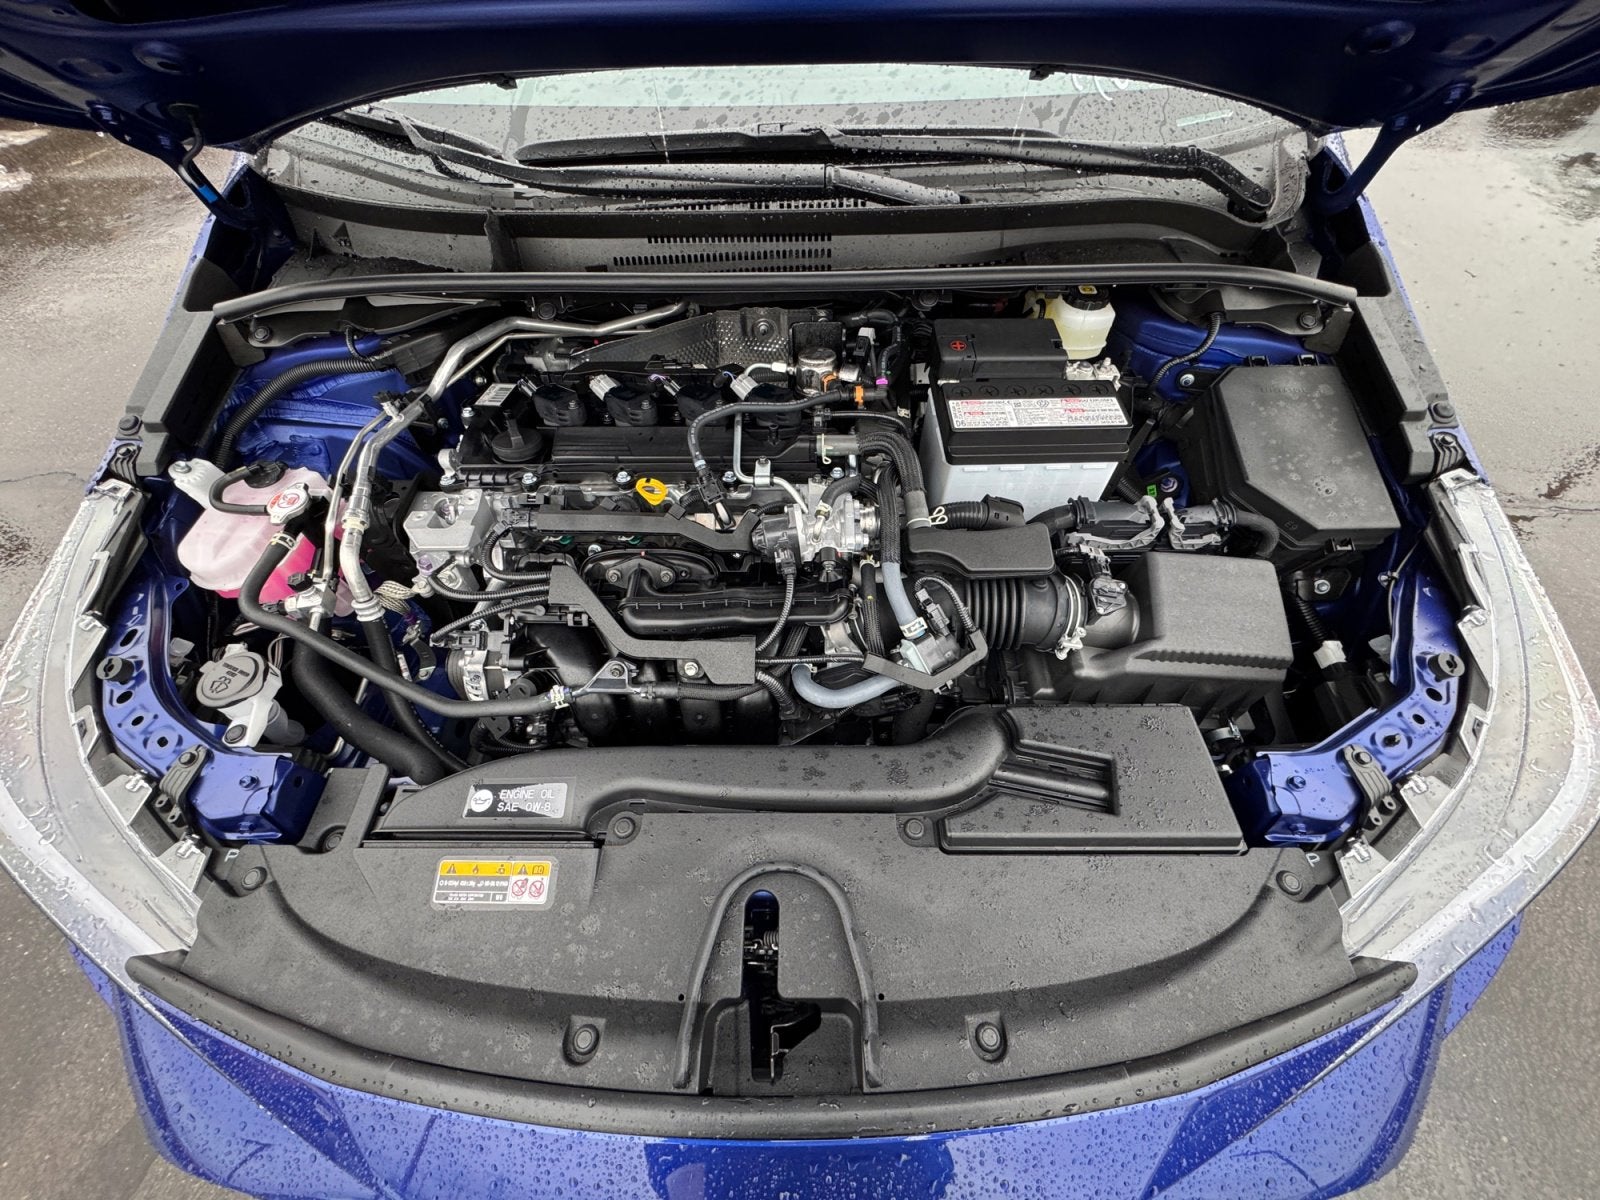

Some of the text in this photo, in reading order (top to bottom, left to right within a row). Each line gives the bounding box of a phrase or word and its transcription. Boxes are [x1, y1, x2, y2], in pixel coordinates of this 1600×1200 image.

[499, 788, 556, 800] ENGINE OIL
[496, 802, 552, 812] SAE 0W-8
